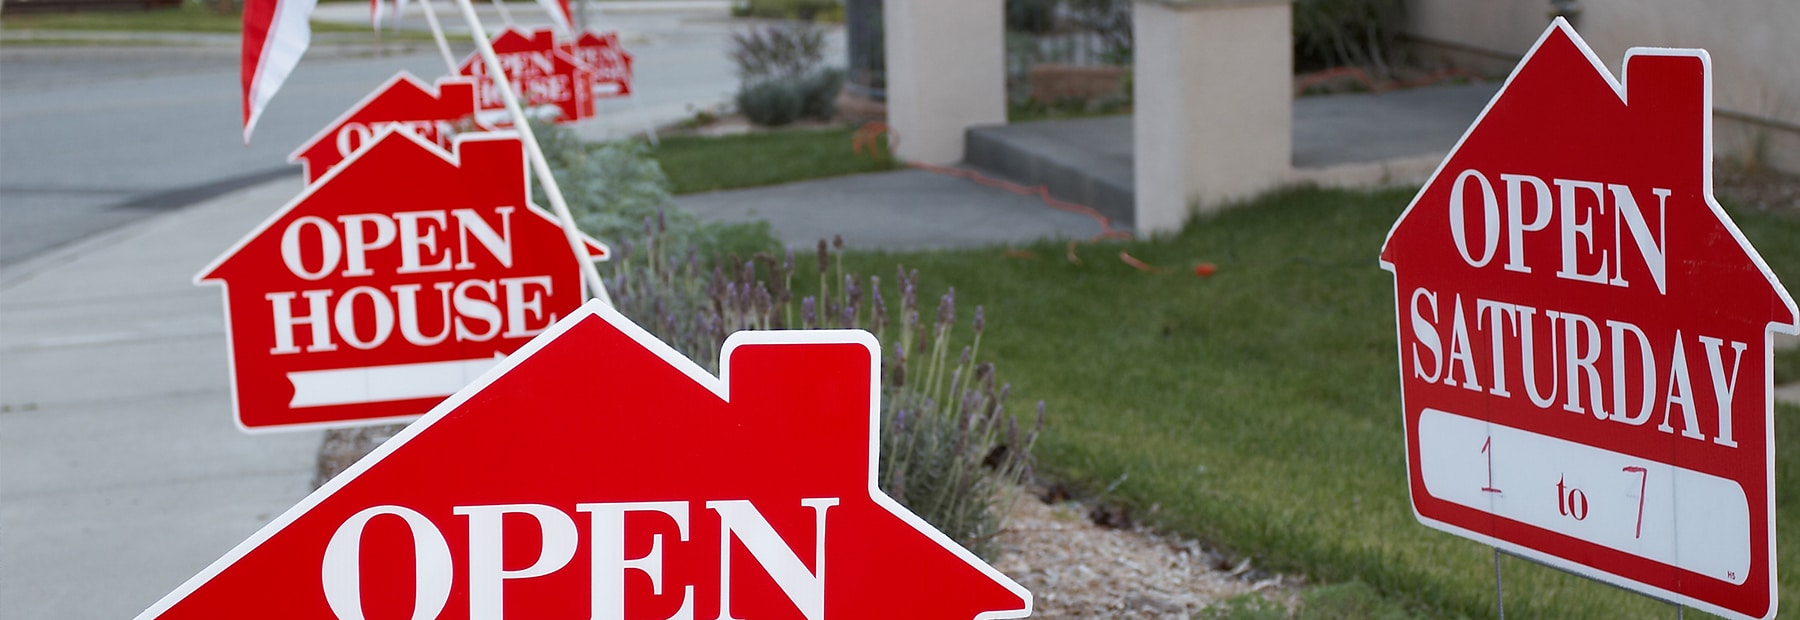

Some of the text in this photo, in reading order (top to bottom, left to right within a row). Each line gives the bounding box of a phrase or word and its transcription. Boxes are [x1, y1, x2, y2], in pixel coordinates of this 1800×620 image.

[281, 206, 515, 280] OPEN
[1449, 169, 1672, 296] OPEN
[265, 276, 557, 355] HOUSE
[1410, 287, 1748, 449] SATURDAY
[1481, 435, 1647, 539] 1 to 7
[322, 497, 840, 620] OPEN
